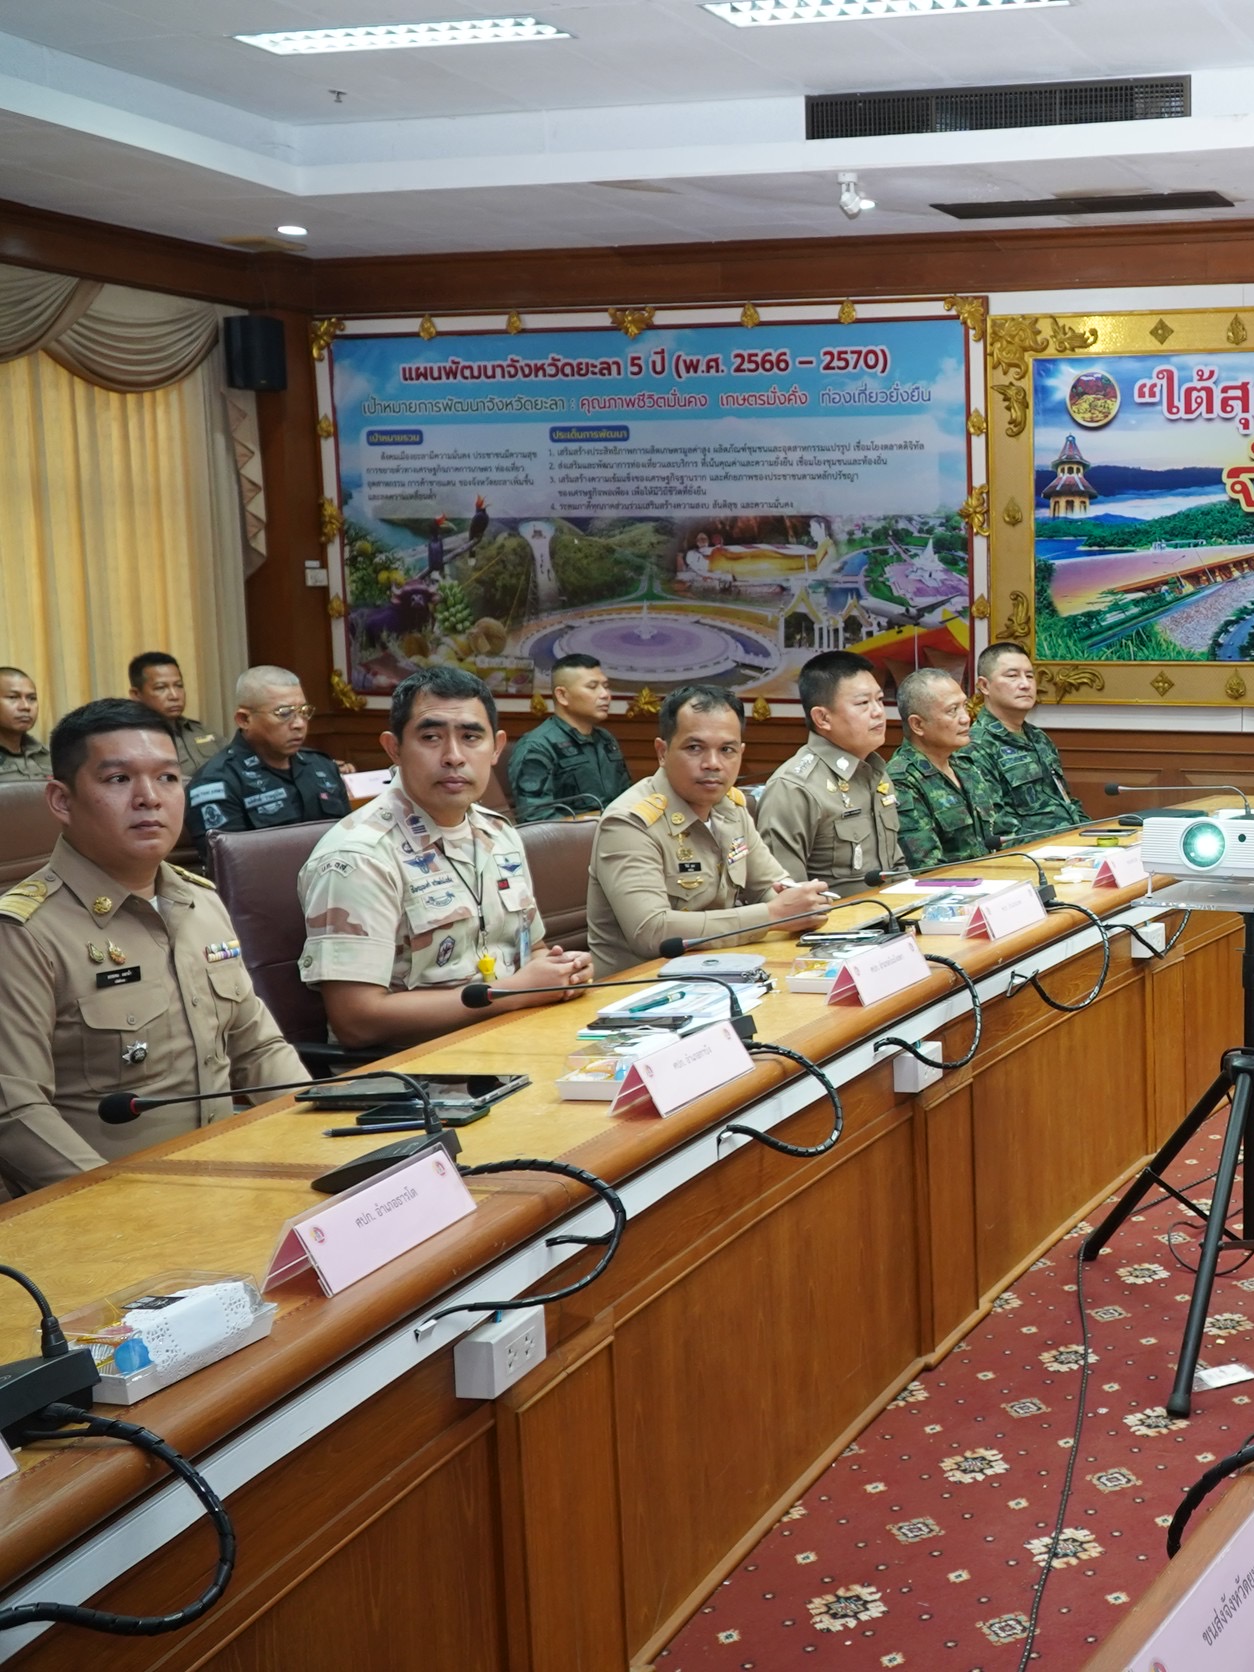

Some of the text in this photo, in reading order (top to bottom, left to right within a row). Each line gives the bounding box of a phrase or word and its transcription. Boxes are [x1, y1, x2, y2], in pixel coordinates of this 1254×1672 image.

[401, 356, 622, 382] แผนพัฒนาจังหวัดยะลา
[629, 355, 643, 376] 5
[651, 348, 666, 375] ปี
[675, 353, 725, 378] (พ.ศ.
[732, 351, 790, 373] 2566
[821, 348, 889, 374] 2570)
[362, 395, 565, 415] เป้าหมายการพัฒนาจังหวัดยะลา
[580, 387, 708, 415] คุณภาพชีวิตมั่นคง
[720, 385, 809, 408] เกษตรมั่งคั่ง
[820, 381, 932, 405] ท่องเที่ยวยั่งยืน
[355, 1212, 376, 1228] ศปก.
